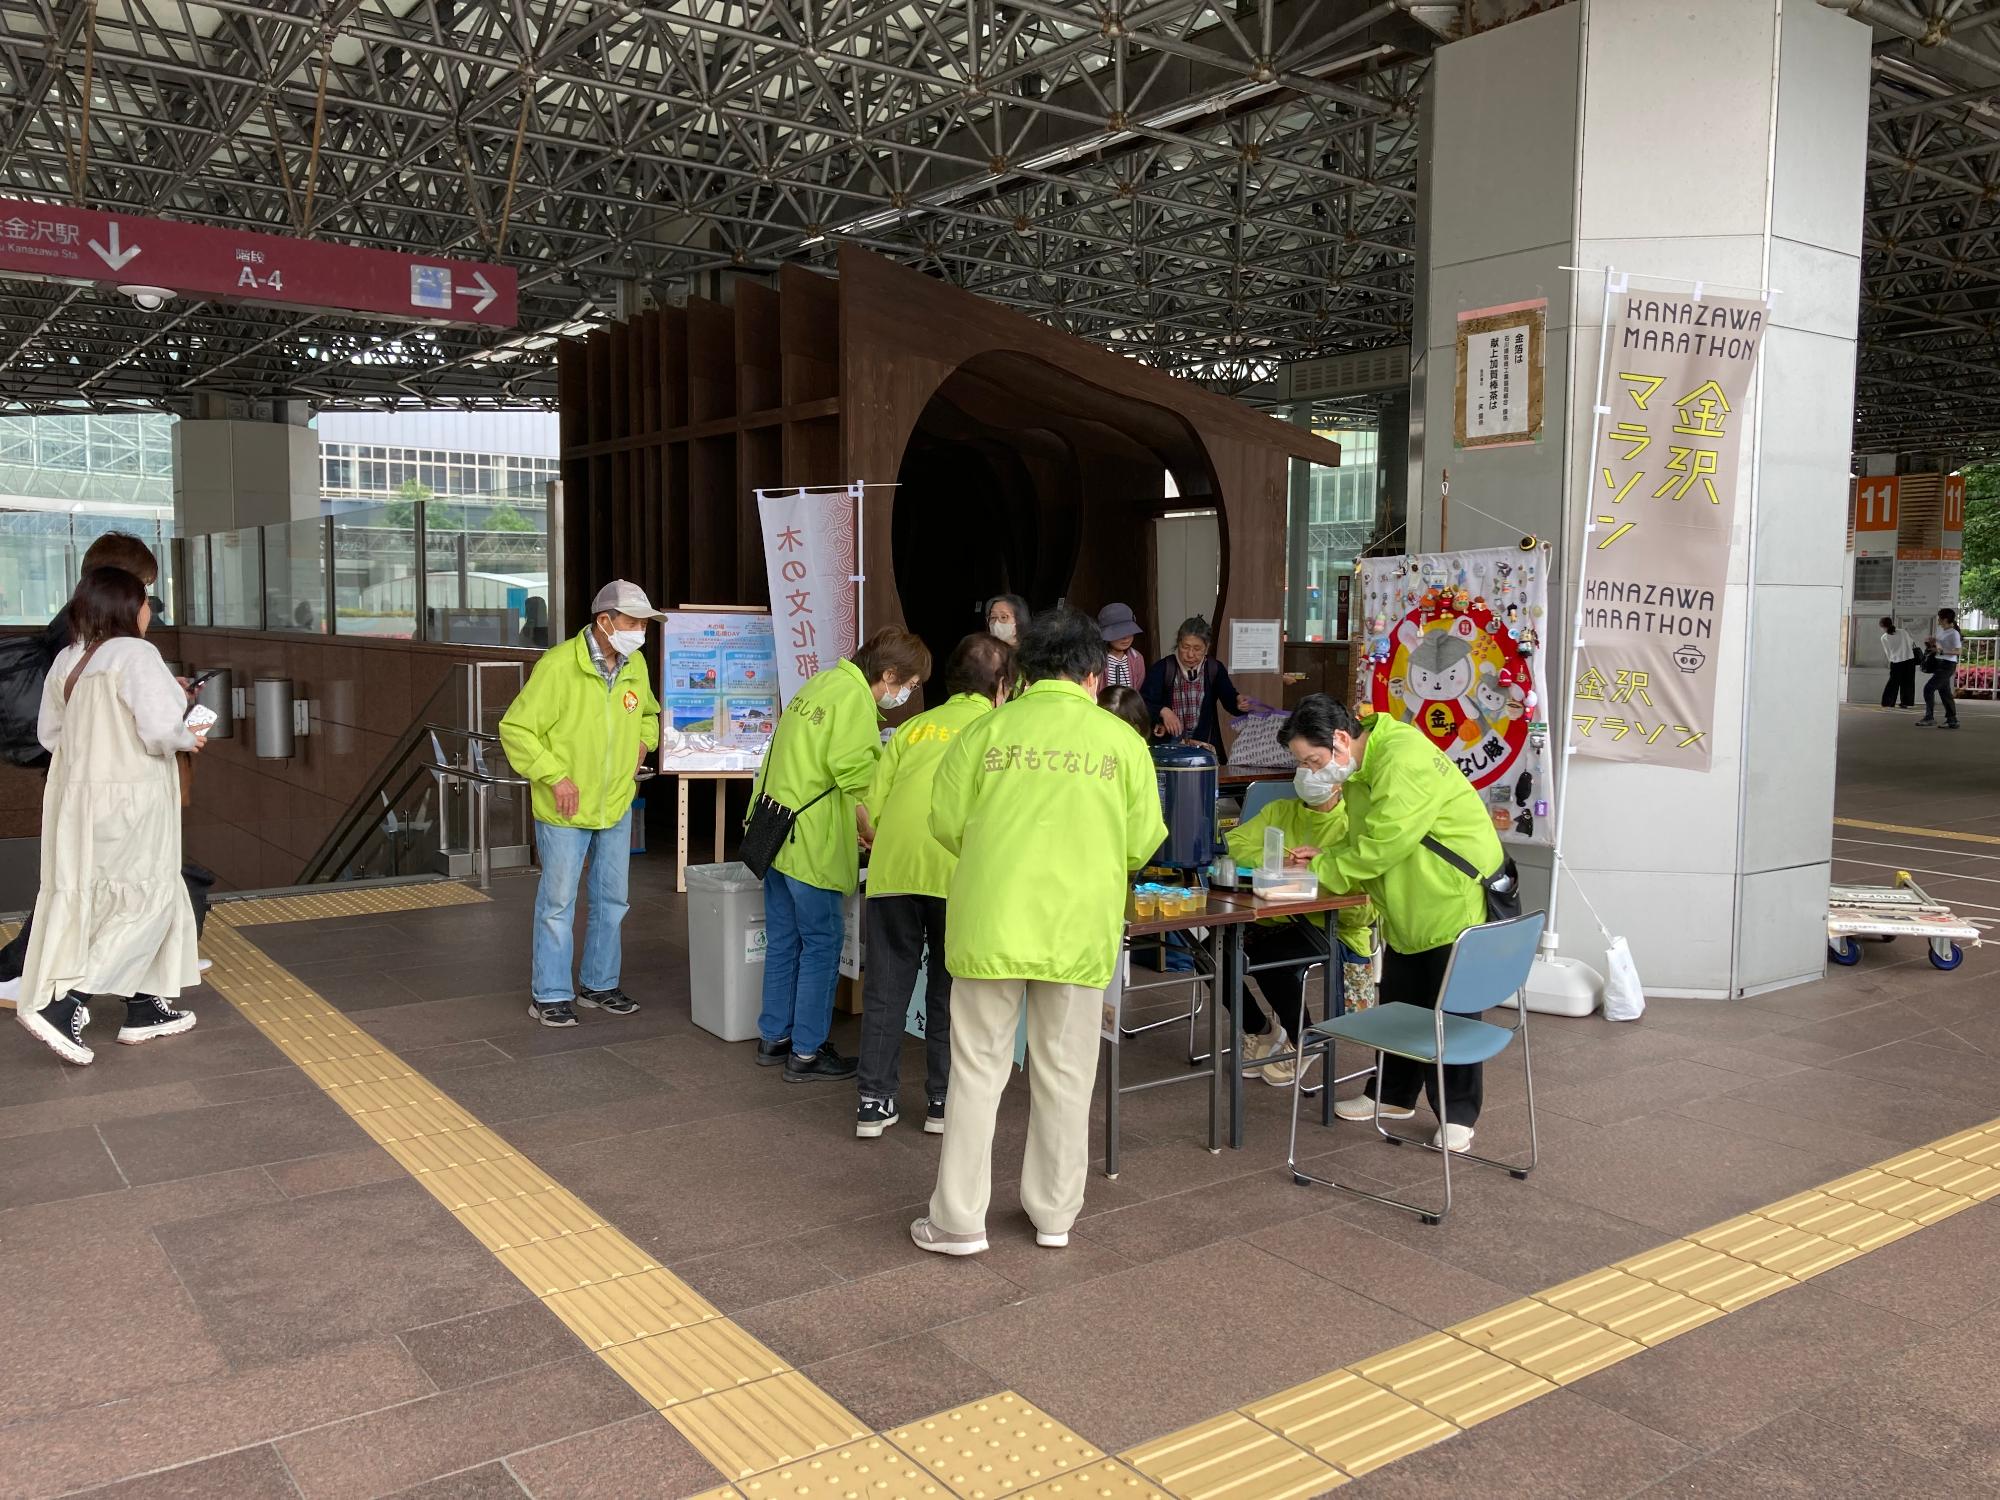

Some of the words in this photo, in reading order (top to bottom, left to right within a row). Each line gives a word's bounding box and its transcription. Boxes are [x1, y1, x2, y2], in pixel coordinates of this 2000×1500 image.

[0, 217, 80, 246] 金沢駅
[8, 243, 59, 257] Kanazawa
[238, 266, 283, 291] A-4
[1627, 298, 1762, 332] KANAZAWA
[1623, 327, 1755, 360] MARATHON
[1652, 380, 1731, 505] 金沢
[1597, 372, 1667, 550] マラソン
[1861, 485, 1892, 523] 11
[1947, 484, 1962, 522] 11
[1586, 579, 1715, 612] KANAZAWA
[1585, 608, 1712, 638] MARATHON
[1575, 666, 1653, 706] 金沢
[1572, 715, 1707, 748] マラソン
[984, 745, 1119, 781] 金沢もてなし隊
